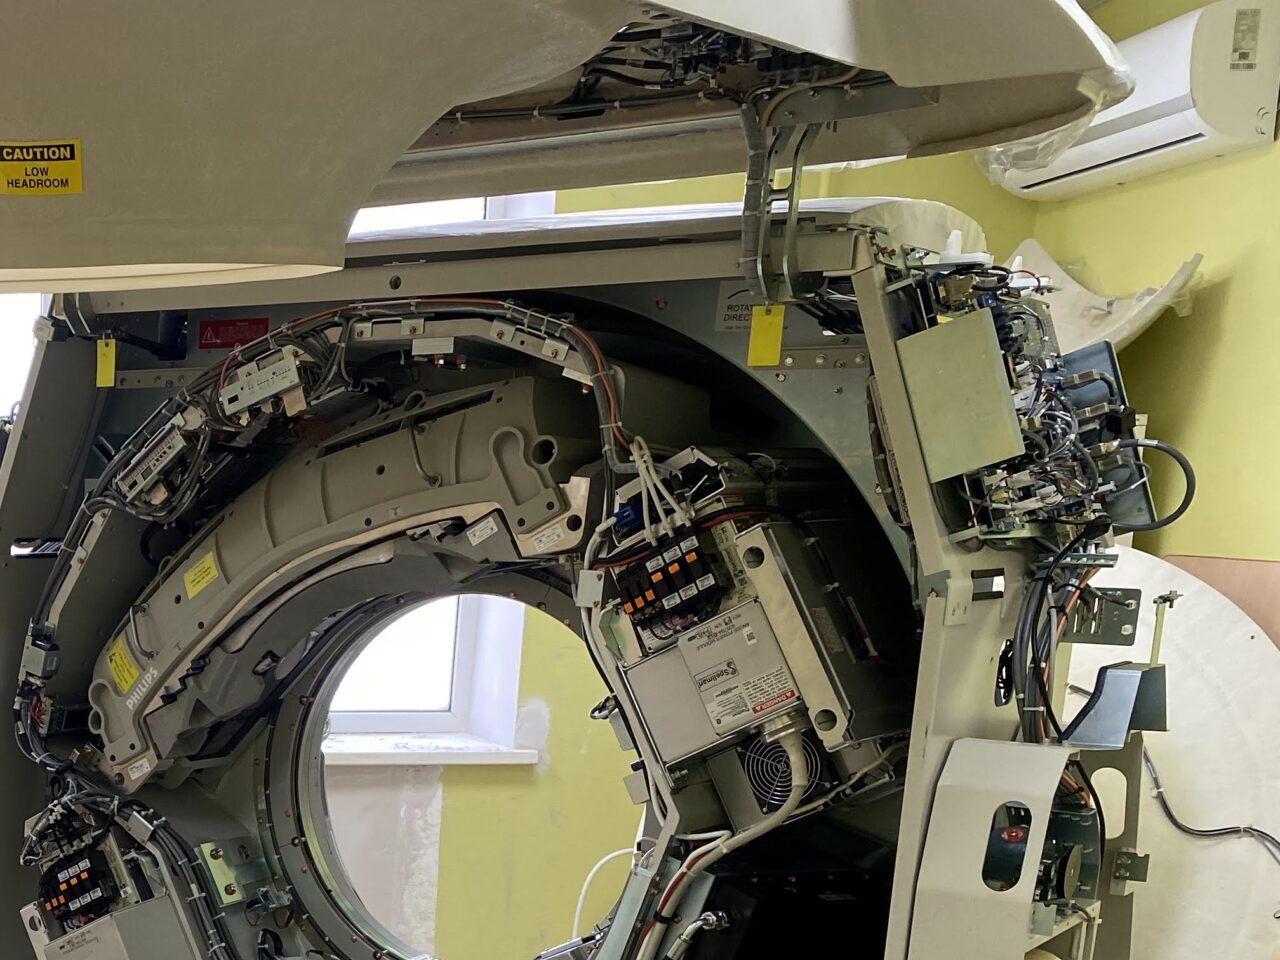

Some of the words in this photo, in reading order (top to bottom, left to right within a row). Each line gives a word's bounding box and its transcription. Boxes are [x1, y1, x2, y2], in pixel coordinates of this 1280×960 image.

[2, 146, 70, 159] CAUTION
[23, 166, 50, 177] LOW
[6, 177, 70, 189] HEADROOM
[723, 313, 753, 321] DIREC
[697, 668, 730, 689] Spellman
[126, 666, 159, 710] PHILIPS
[761, 694, 787, 709] DANGER
